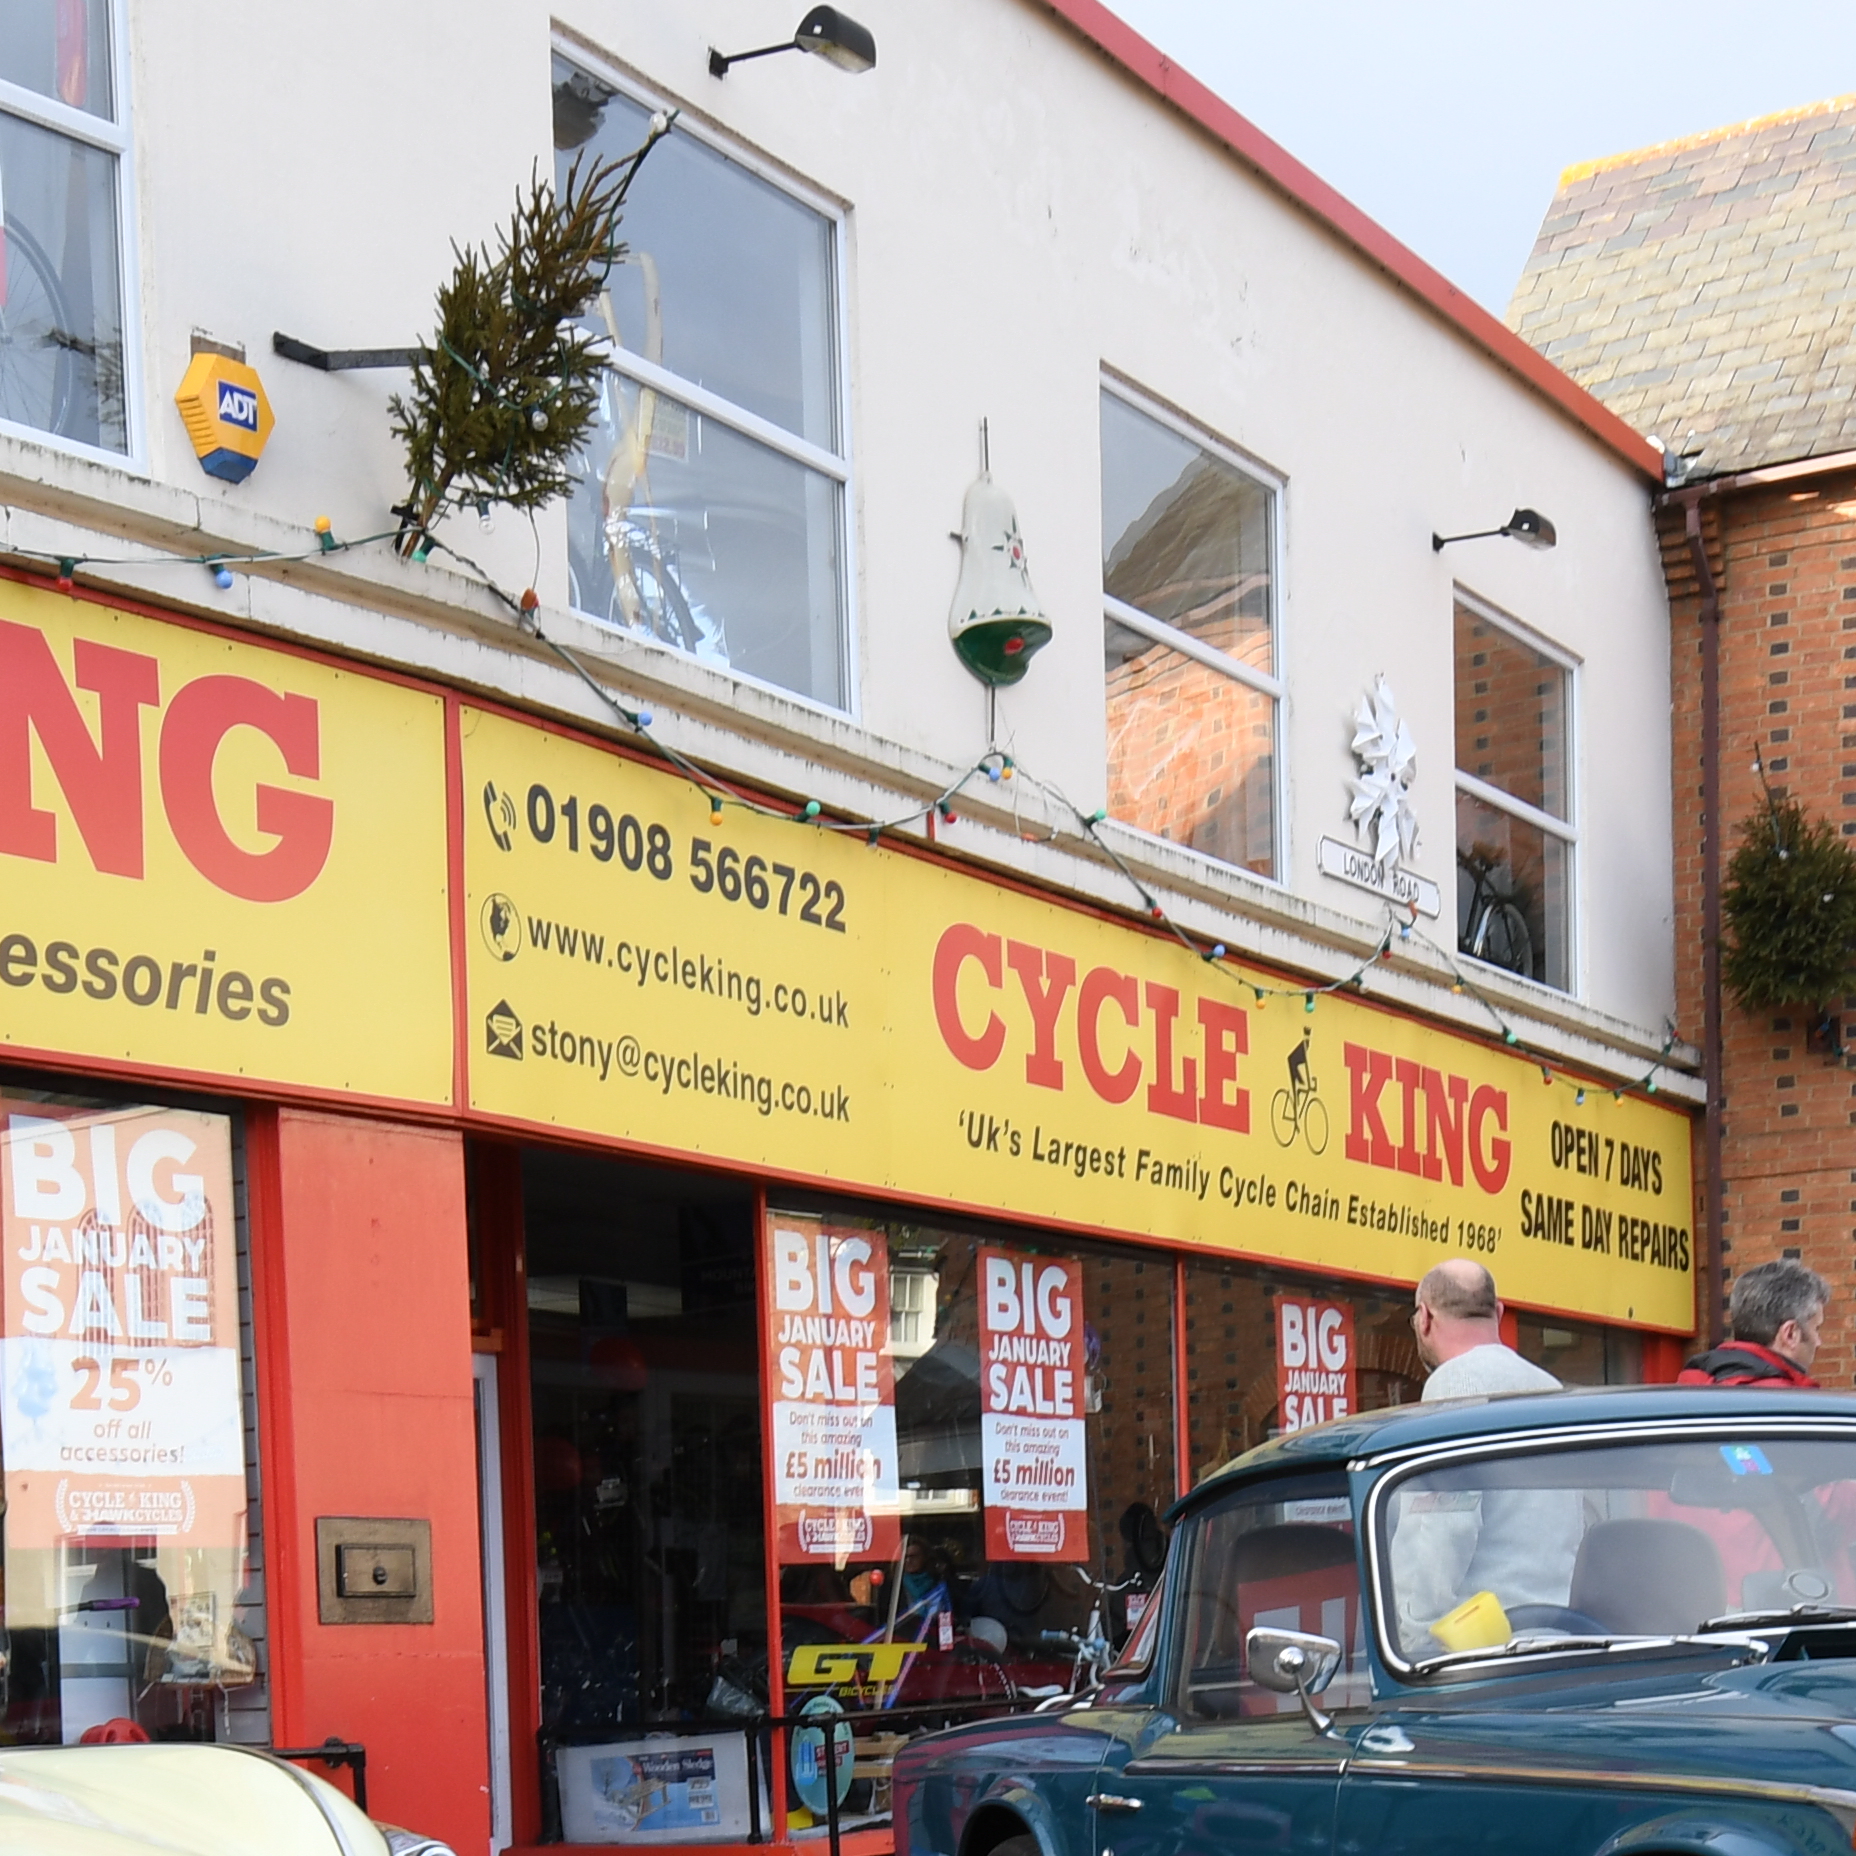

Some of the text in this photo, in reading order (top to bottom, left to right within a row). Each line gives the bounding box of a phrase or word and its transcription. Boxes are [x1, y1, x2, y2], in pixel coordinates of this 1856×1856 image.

[219, 390, 258, 425] ADT
[527, 783, 847, 934] 01908 566722
[1343, 851, 1385, 889] LONDON
[527, 912, 850, 1030] www.cycleking.co.uk
[530, 1018, 851, 1122] stony@cycleking.co.uk
[932, 922, 1512, 1195] CYCLE KING
[7, 1114, 207, 1233] BIG
[1551, 1118, 1663, 1195] OPEN 7 DAYS
[1032, 1125, 1126, 1184] Largest
[1136, 1148, 1211, 1201] Family
[1219, 1164, 1277, 1210] Cycle
[1285, 1179, 1341, 1222] Chain
[1347, 1191, 1449, 1245] Established
[18, 1225, 206, 1274] JANUARY
[1521, 1188, 1690, 1272] SAME DAY REPAIRS
[773, 1229, 876, 1317] BIG
[19, 1266, 212, 1343] SALE
[985, 1256, 1072, 1339] BIG
[778, 1314, 876, 1349] JANUARY
[988, 1333, 1072, 1368] JANUARY
[1280, 1303, 1348, 1371] BIG
[70, 1356, 174, 1412] 25%
[778, 1346, 879, 1402] SALE
[988, 1362, 1074, 1416] SALE
[1284, 1368, 1348, 1395] JANUARY
[94, 1419, 152, 1440] off all
[790, 1411, 815, 1426] Don't
[817, 1412, 840, 1427] miss
[995, 1422, 1070, 1440] Don't miss out on
[1284, 1395, 1348, 1434] SALE
[60, 1444, 186, 1463] accessories!
[801, 1430, 862, 1447] this amazing
[1005, 1439, 1061, 1457] this amazing
[785, 1449, 882, 1480] £5 million
[993, 1456, 1075, 1487] £5 million
[68, 1491, 183, 1509] CYCLE KING
[793, 1484, 841, 1498] clearance
[1000, 1487, 1069, 1503] clearance event!
[787, 1643, 928, 1685] GT
[642, 1758, 712, 1773] Wooden Sledge
